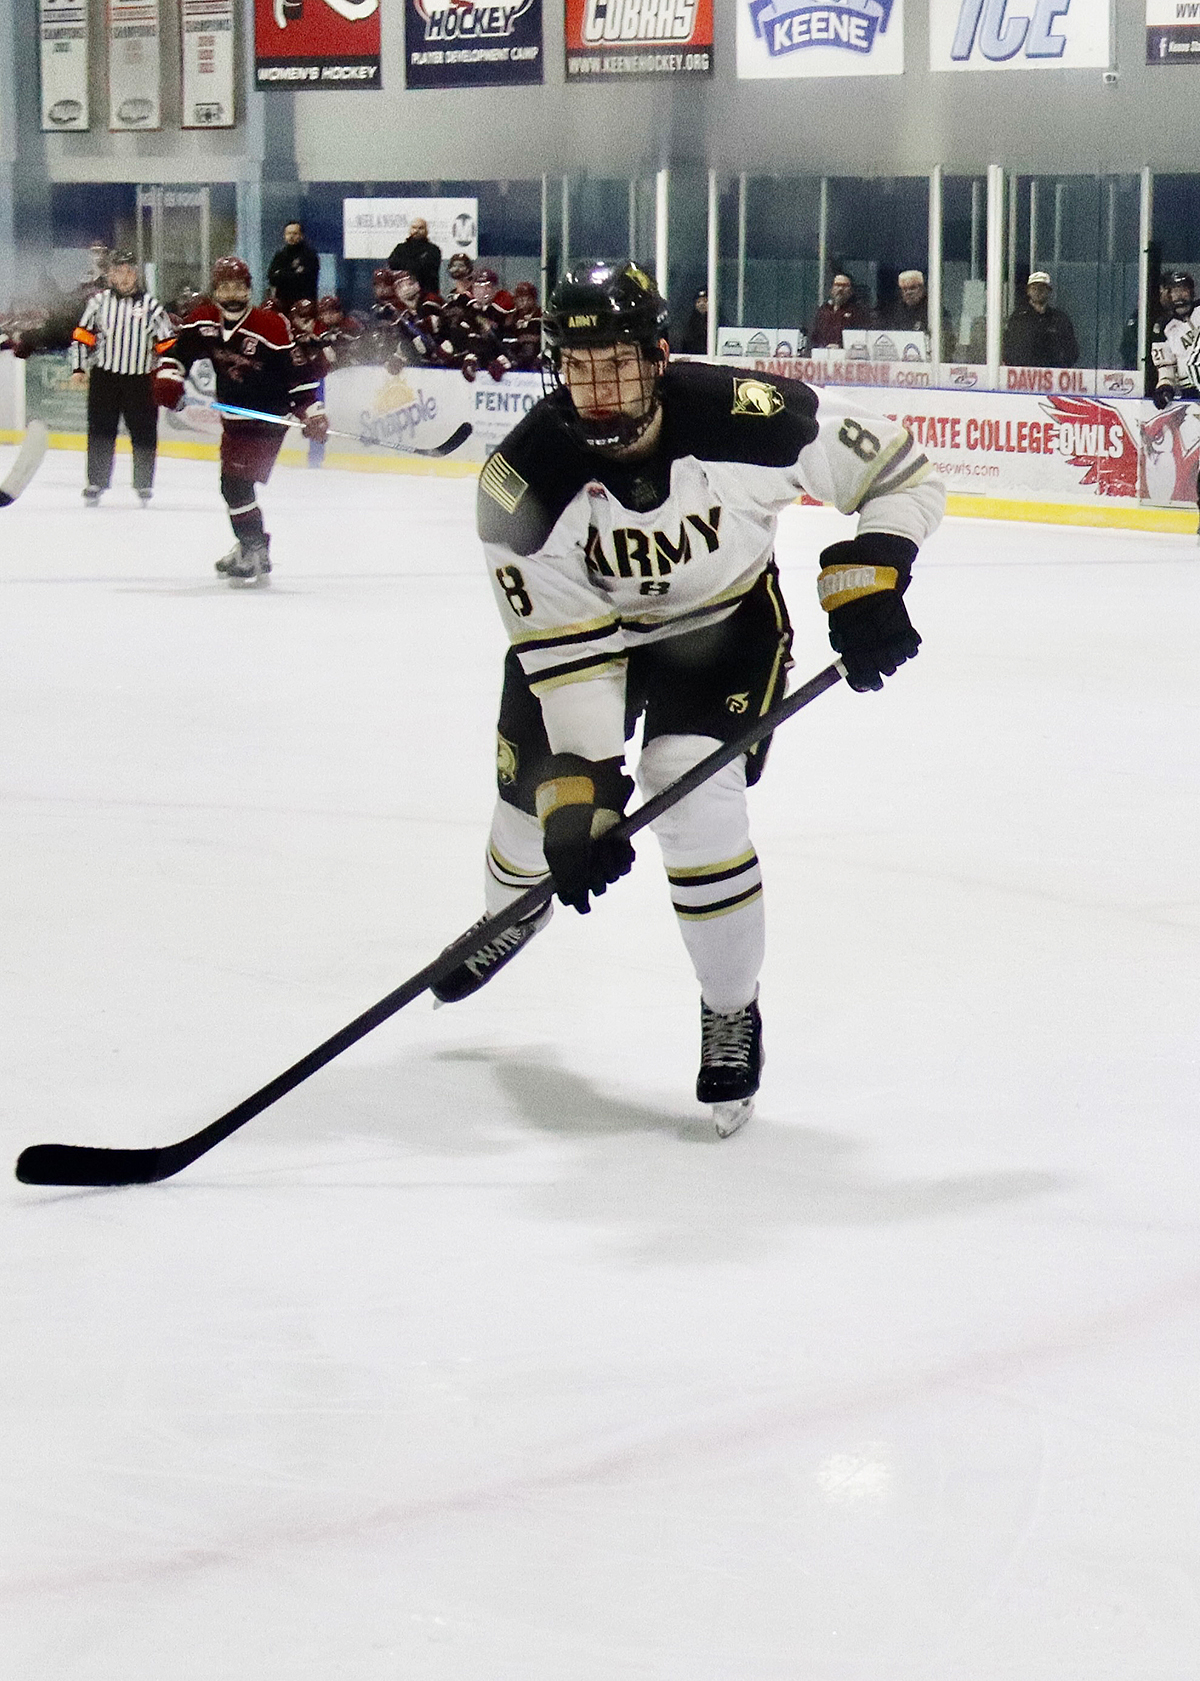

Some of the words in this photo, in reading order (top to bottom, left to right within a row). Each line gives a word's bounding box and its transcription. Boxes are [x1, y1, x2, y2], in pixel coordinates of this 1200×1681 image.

[426, 6, 515, 40] HOCKEY
[773, 10, 870, 51] KEENE
[951, 0, 1068, 62] ICE
[445, 48, 510, 63] DEVELOPMENT
[568, 53, 710, 73] WWW.KEENEHOCKEY.ORG
[257, 66, 319, 81] WOMEN'S
[322, 65, 378, 80] HOCKEY
[568, 314, 598, 328] ARMY
[1007, 368, 1054, 392] DAVIS
[1058, 370, 1087, 393] OIL
[359, 388, 437, 444] Snapple
[475, 390, 542, 413] FENTO
[838, 417, 881, 463] 8
[966, 417, 1057, 455] COLLEGE
[1058, 422, 1124, 459] OWLS
[933, 461, 1000, 478] neowls.com
[583, 504, 722, 578] ARMY
[495, 563, 534, 618] 8
